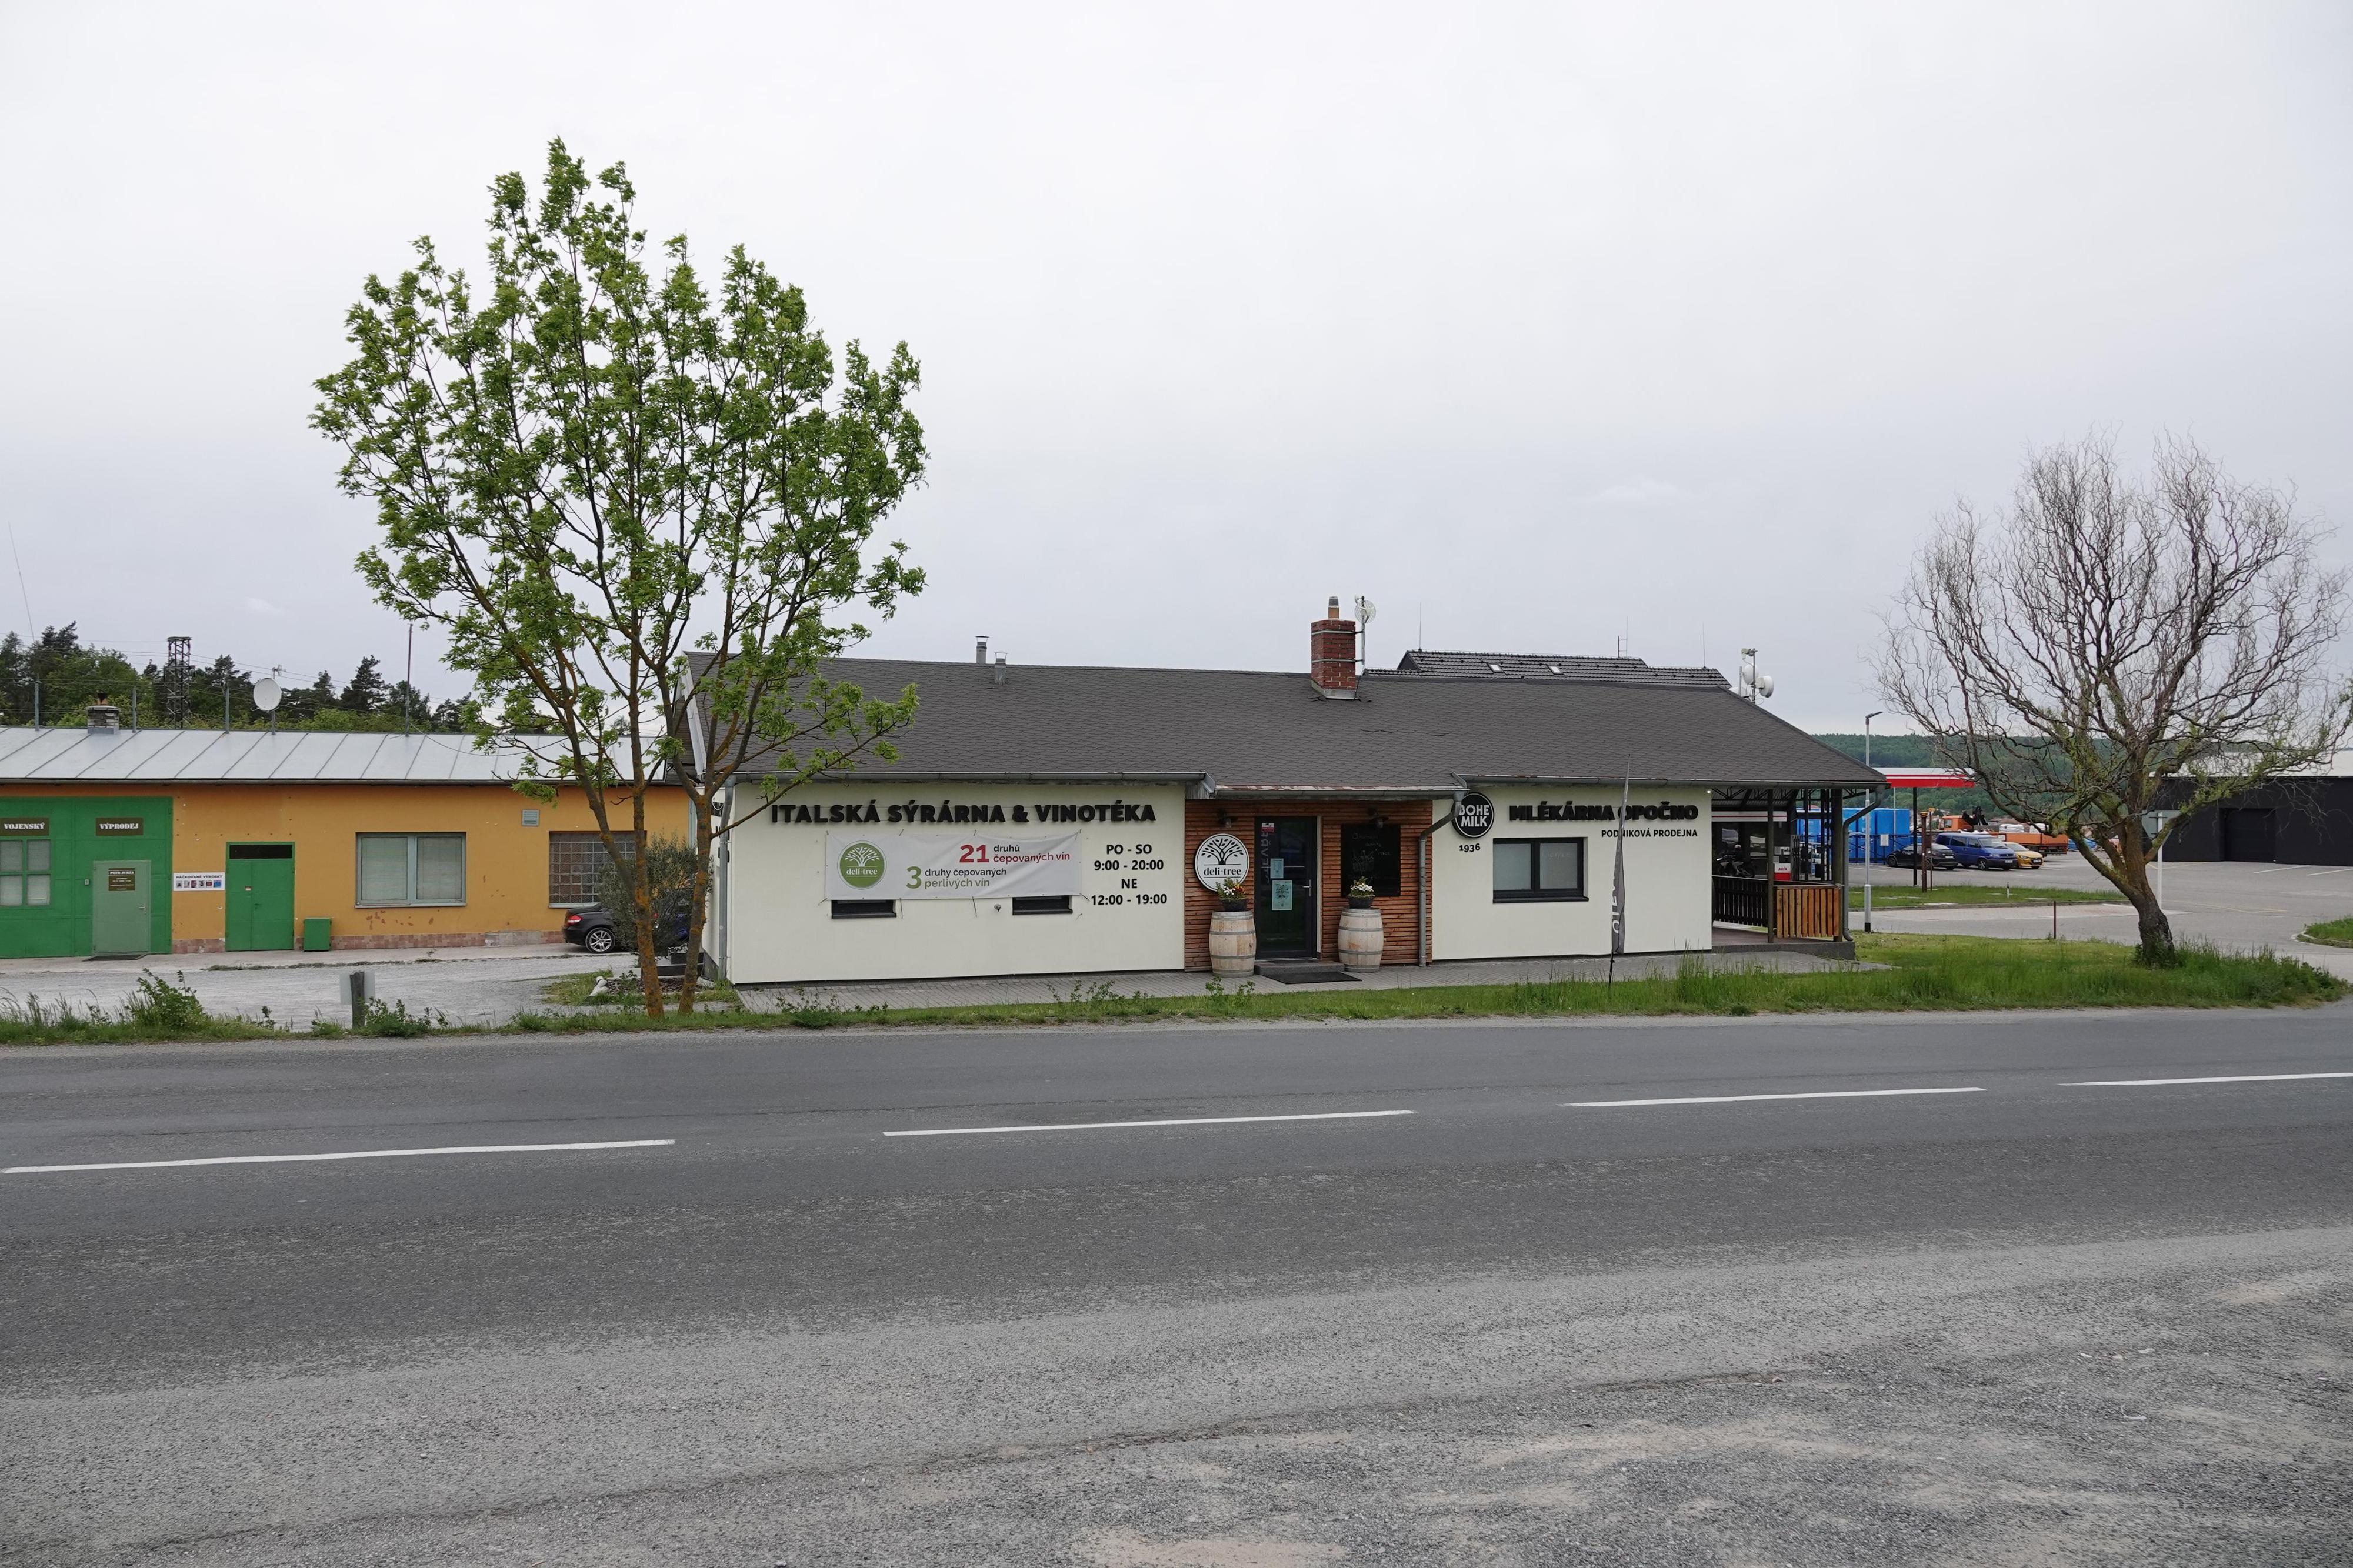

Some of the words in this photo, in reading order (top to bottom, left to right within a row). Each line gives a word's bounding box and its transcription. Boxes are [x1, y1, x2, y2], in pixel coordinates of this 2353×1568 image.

[771, 799, 881, 823] ITALSKÁ
[887, 800, 1006, 823] SÝRÁRNA
[1012, 805, 1029, 822] &
[1034, 800, 1156, 822] VINOTÉKA
[1459, 805, 1489, 816] BOHE
[1509, 800, 1615, 820] MLÉKÁRNA
[1618, 801, 1699, 820] OPOČNO
[1461, 816, 1487, 827] MILK
[959, 844, 989, 863] 21
[993, 844, 1020, 852] druhů
[1106, 844, 1124, 855] PO
[1135, 844, 1152, 854] SO
[1459, 843, 1481, 853] 1936
[993, 853, 1054, 865] čepovaných
[1056, 851, 1070, 860] vín
[1094, 860, 1119, 870] 9:00
[1131, 859, 1164, 870] 20:00
[906, 866, 922, 889] 3
[924, 868, 951, 878] druhy
[953, 868, 1006, 878] čepovaných
[925, 878, 972, 890] perlivých
[975, 878, 990, 887] vín
[1121, 878, 1138, 889] NE
[1091, 894, 1123, 905] 12:00
[1135, 893, 1168, 905] 19:00
